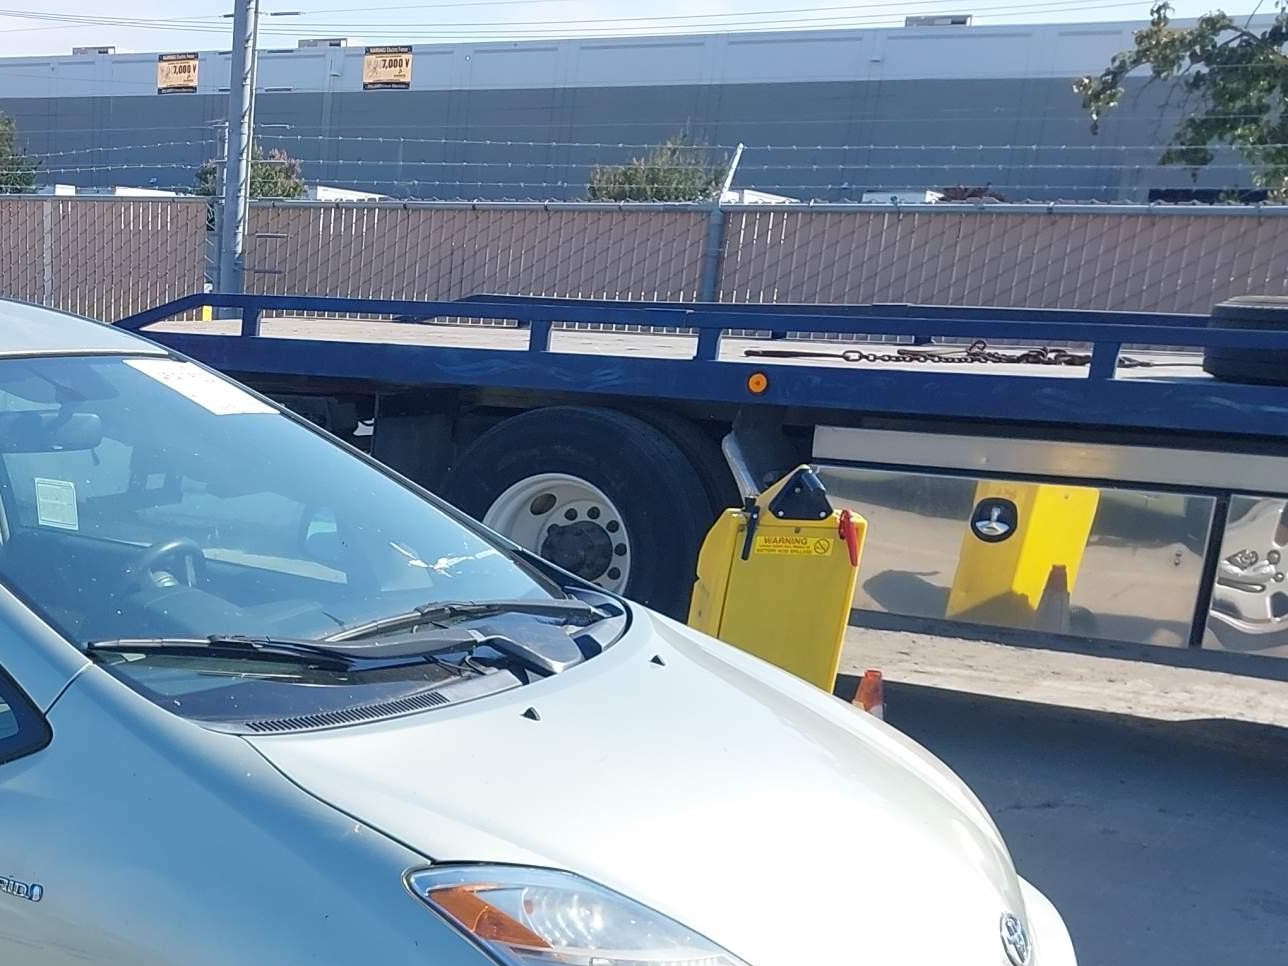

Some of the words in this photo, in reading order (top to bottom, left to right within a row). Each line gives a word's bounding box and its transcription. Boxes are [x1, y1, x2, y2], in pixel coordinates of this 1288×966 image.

[173, 64, 191, 75] 7,000
[192, 63, 197, 73] V
[382, 58, 404, 70] 7,000
[405, 58, 410, 68] V
[764, 536, 808, 545] WARNING
